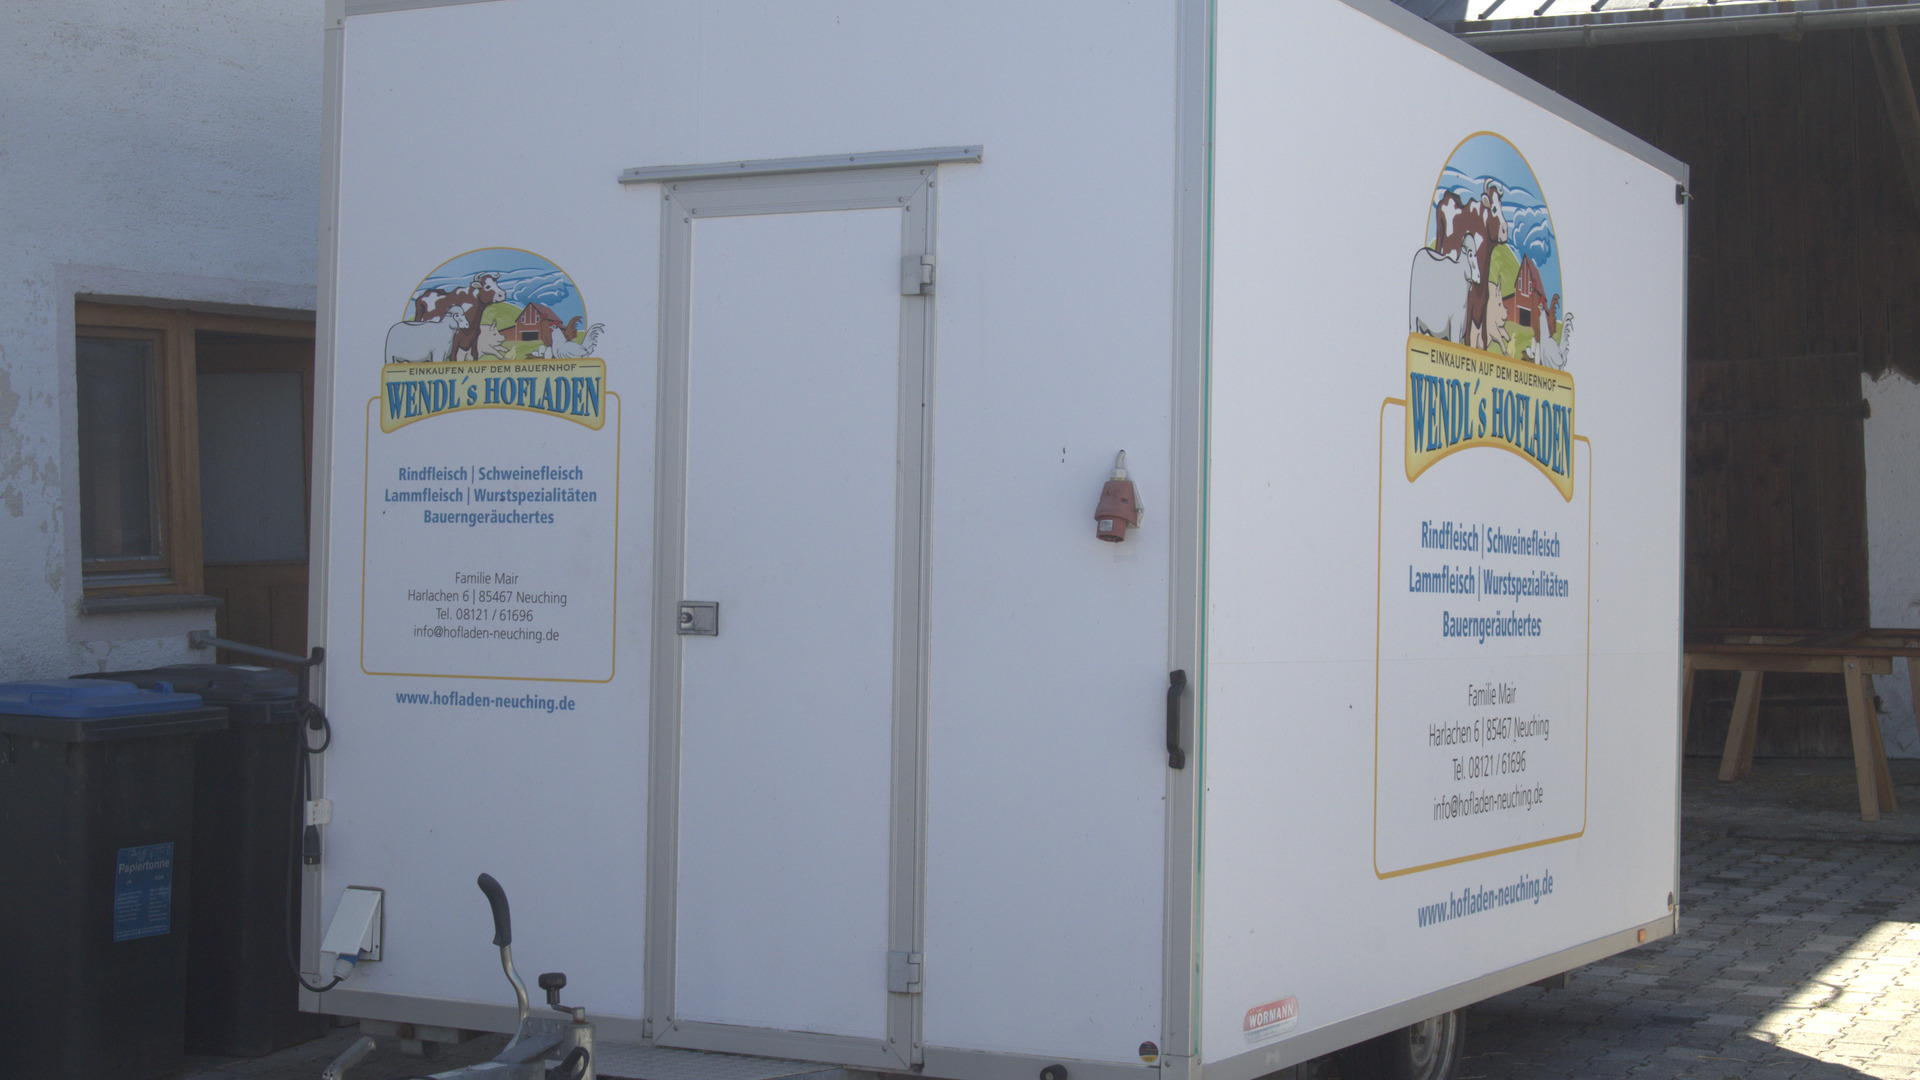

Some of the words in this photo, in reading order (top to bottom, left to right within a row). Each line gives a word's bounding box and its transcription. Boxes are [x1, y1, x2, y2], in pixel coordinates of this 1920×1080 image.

[409, 365, 465, 376] EINKAUFEN
[467, 365, 487, 374] AUF
[490, 364, 512, 374] DEM
[514, 363, 577, 373] BAUERNHOF
[1430, 349, 1477, 373] EINKAUFEN
[1478, 362, 1494, 377] AUF
[1496, 366, 1512, 382] DEM
[1513, 369, 1557, 391] BAUERNHOF
[483, 376, 602, 418] HOFLADEN
[1491, 387, 1572, 479] HOFLADEN
[398, 466, 468, 481] Rindfleisch
[478, 465, 583, 481] Schweinefleisch
[385, 488, 463, 502] Lammfleisch
[473, 487, 597, 505] Wurstspezialitäten
[423, 509, 555, 527] Bauerngeräuchertes
[1421, 519, 1479, 552] Rindfleisch
[1487, 526, 1560, 558] Schweinefleisch
[455, 572, 491, 584] Familie
[494, 572, 519, 585] Mair
[1409, 564, 1475, 594] Lammfleisch
[1483, 568, 1569, 603] Wurstspezialitäten
[407, 589, 459, 602] Harlachen
[462, 590, 470, 602] 6
[478, 590, 513, 603] 85467
[516, 590, 567, 607] Neuching
[435, 607, 452, 620] Tel.
[456, 608, 488, 621] 08121
[499, 609, 534, 622] 61696
[413, 625, 559, 643] info@hofladen-neuching.de
[1442, 610, 1542, 645] Bauerngeräuchertes
[396, 690, 576, 713] www.hofladen-neuching.de
[1468, 682, 1496, 707] Familie
[1498, 681, 1517, 705] Mair
[1429, 720, 1472, 747] Harlachen
[1473, 719, 1480, 743] 6
[1486, 717, 1512, 741] 85467
[1513, 714, 1549, 741] Neuching
[1452, 756, 1466, 781] Tel.
[1468, 754, 1494, 779] 08121
[1501, 750, 1526, 775] 61696
[1433, 781, 1543, 821] info@hofladen-neuching.de
[118, 859, 170, 874] Papiertonne
[1417, 869, 1553, 928] www.hofladen-neuching.de
[1249, 1003, 1294, 1028] WÖRMANN
